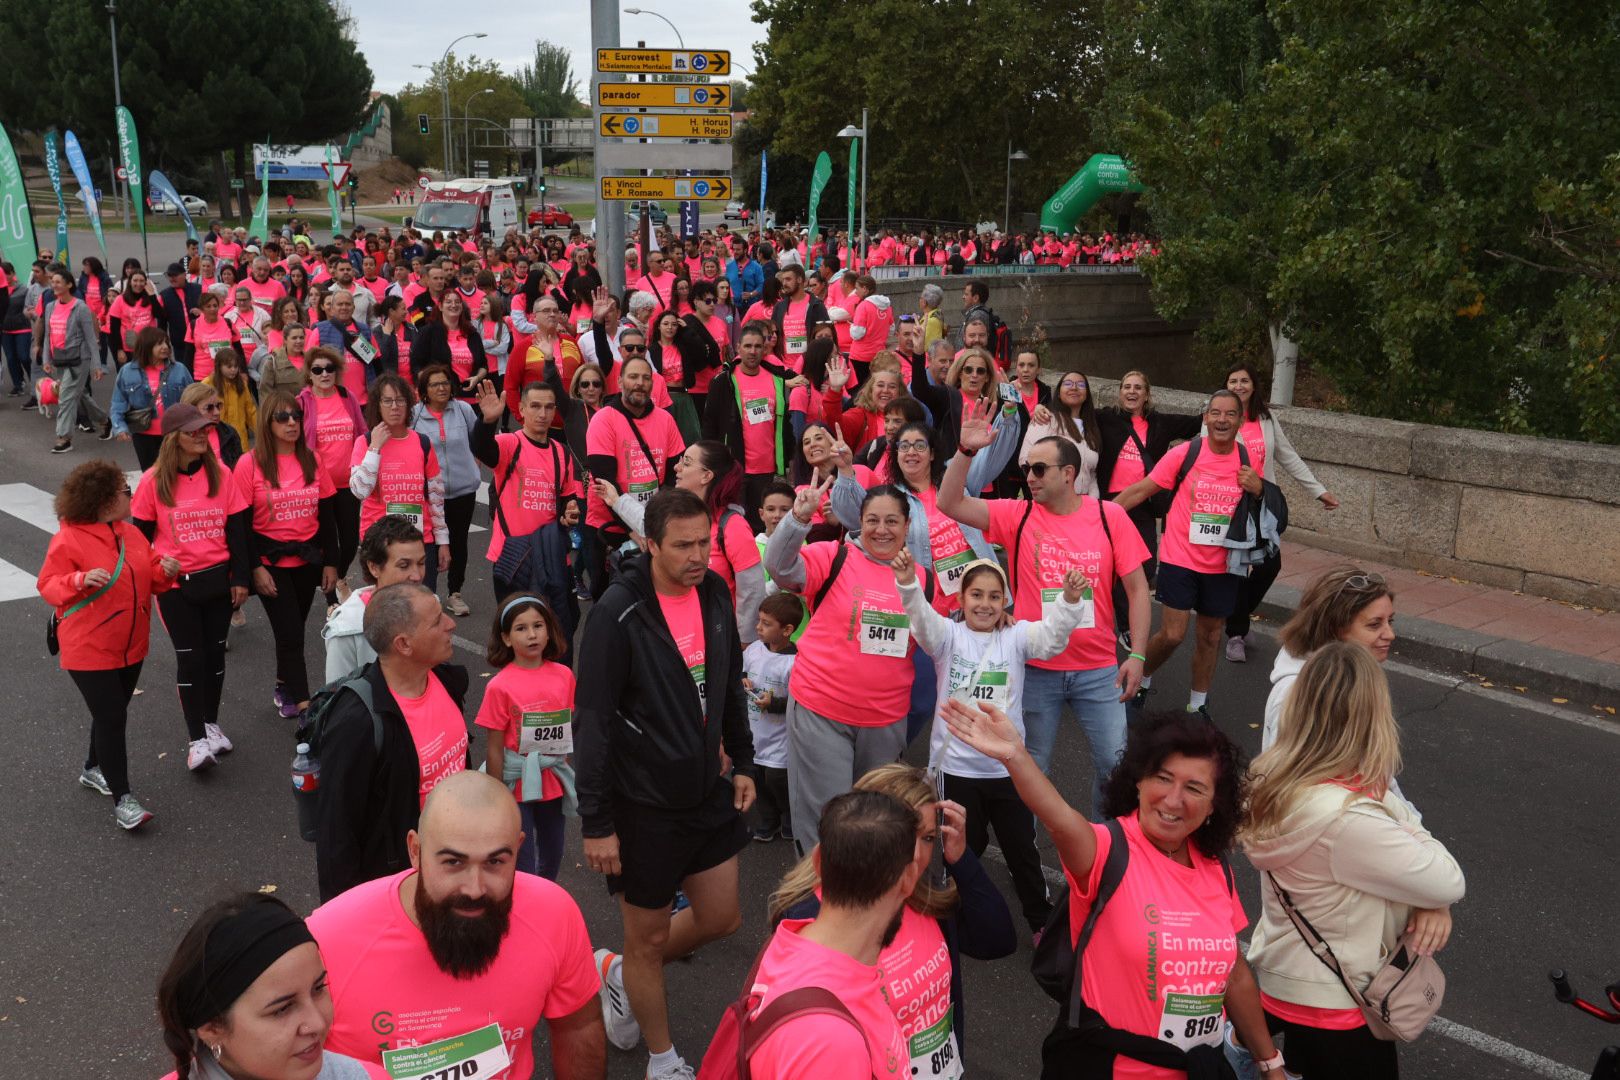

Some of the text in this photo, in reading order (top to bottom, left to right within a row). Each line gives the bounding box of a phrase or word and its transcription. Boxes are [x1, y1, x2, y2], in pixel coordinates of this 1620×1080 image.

[600, 52, 660, 61] H. Eurowest
[602, 91, 641, 102] parador
[690, 118, 728, 126] H. Horus
[704, 127, 728, 136] Regio
[604, 180, 642, 188] H. Vincci
[628, 189, 664, 197] Romano
[382, 472, 394, 480] En
[382, 482, 417, 491] contra
[525, 478, 536, 486] En
[1198, 480, 1210, 489] En
[272, 491, 285, 500] En
[1196, 492, 1232, 503] contra
[274, 498, 310, 510] contra
[1196, 501, 1236, 514] cánce
[174, 512, 188, 520] En
[176, 519, 214, 530] contra
[1200, 524, 1221, 535] 7649
[1042, 543, 1056, 554] En
[1087, 562, 1100, 574] el
[868, 626, 896, 642] 5414
[534, 726, 564, 741] 9248
[422, 762, 439, 777] En
[1162, 932, 1182, 950] En
[1161, 956, 1228, 976] contra
[890, 978, 913, 999] En
[897, 972, 950, 1020] contra
[392, 1052, 428, 1062] Salamanca
[438, 1041, 464, 1054] marcha
[393, 1060, 415, 1070] contra
[416, 1058, 423, 1066] el
[424, 1054, 446, 1065] cáncer
